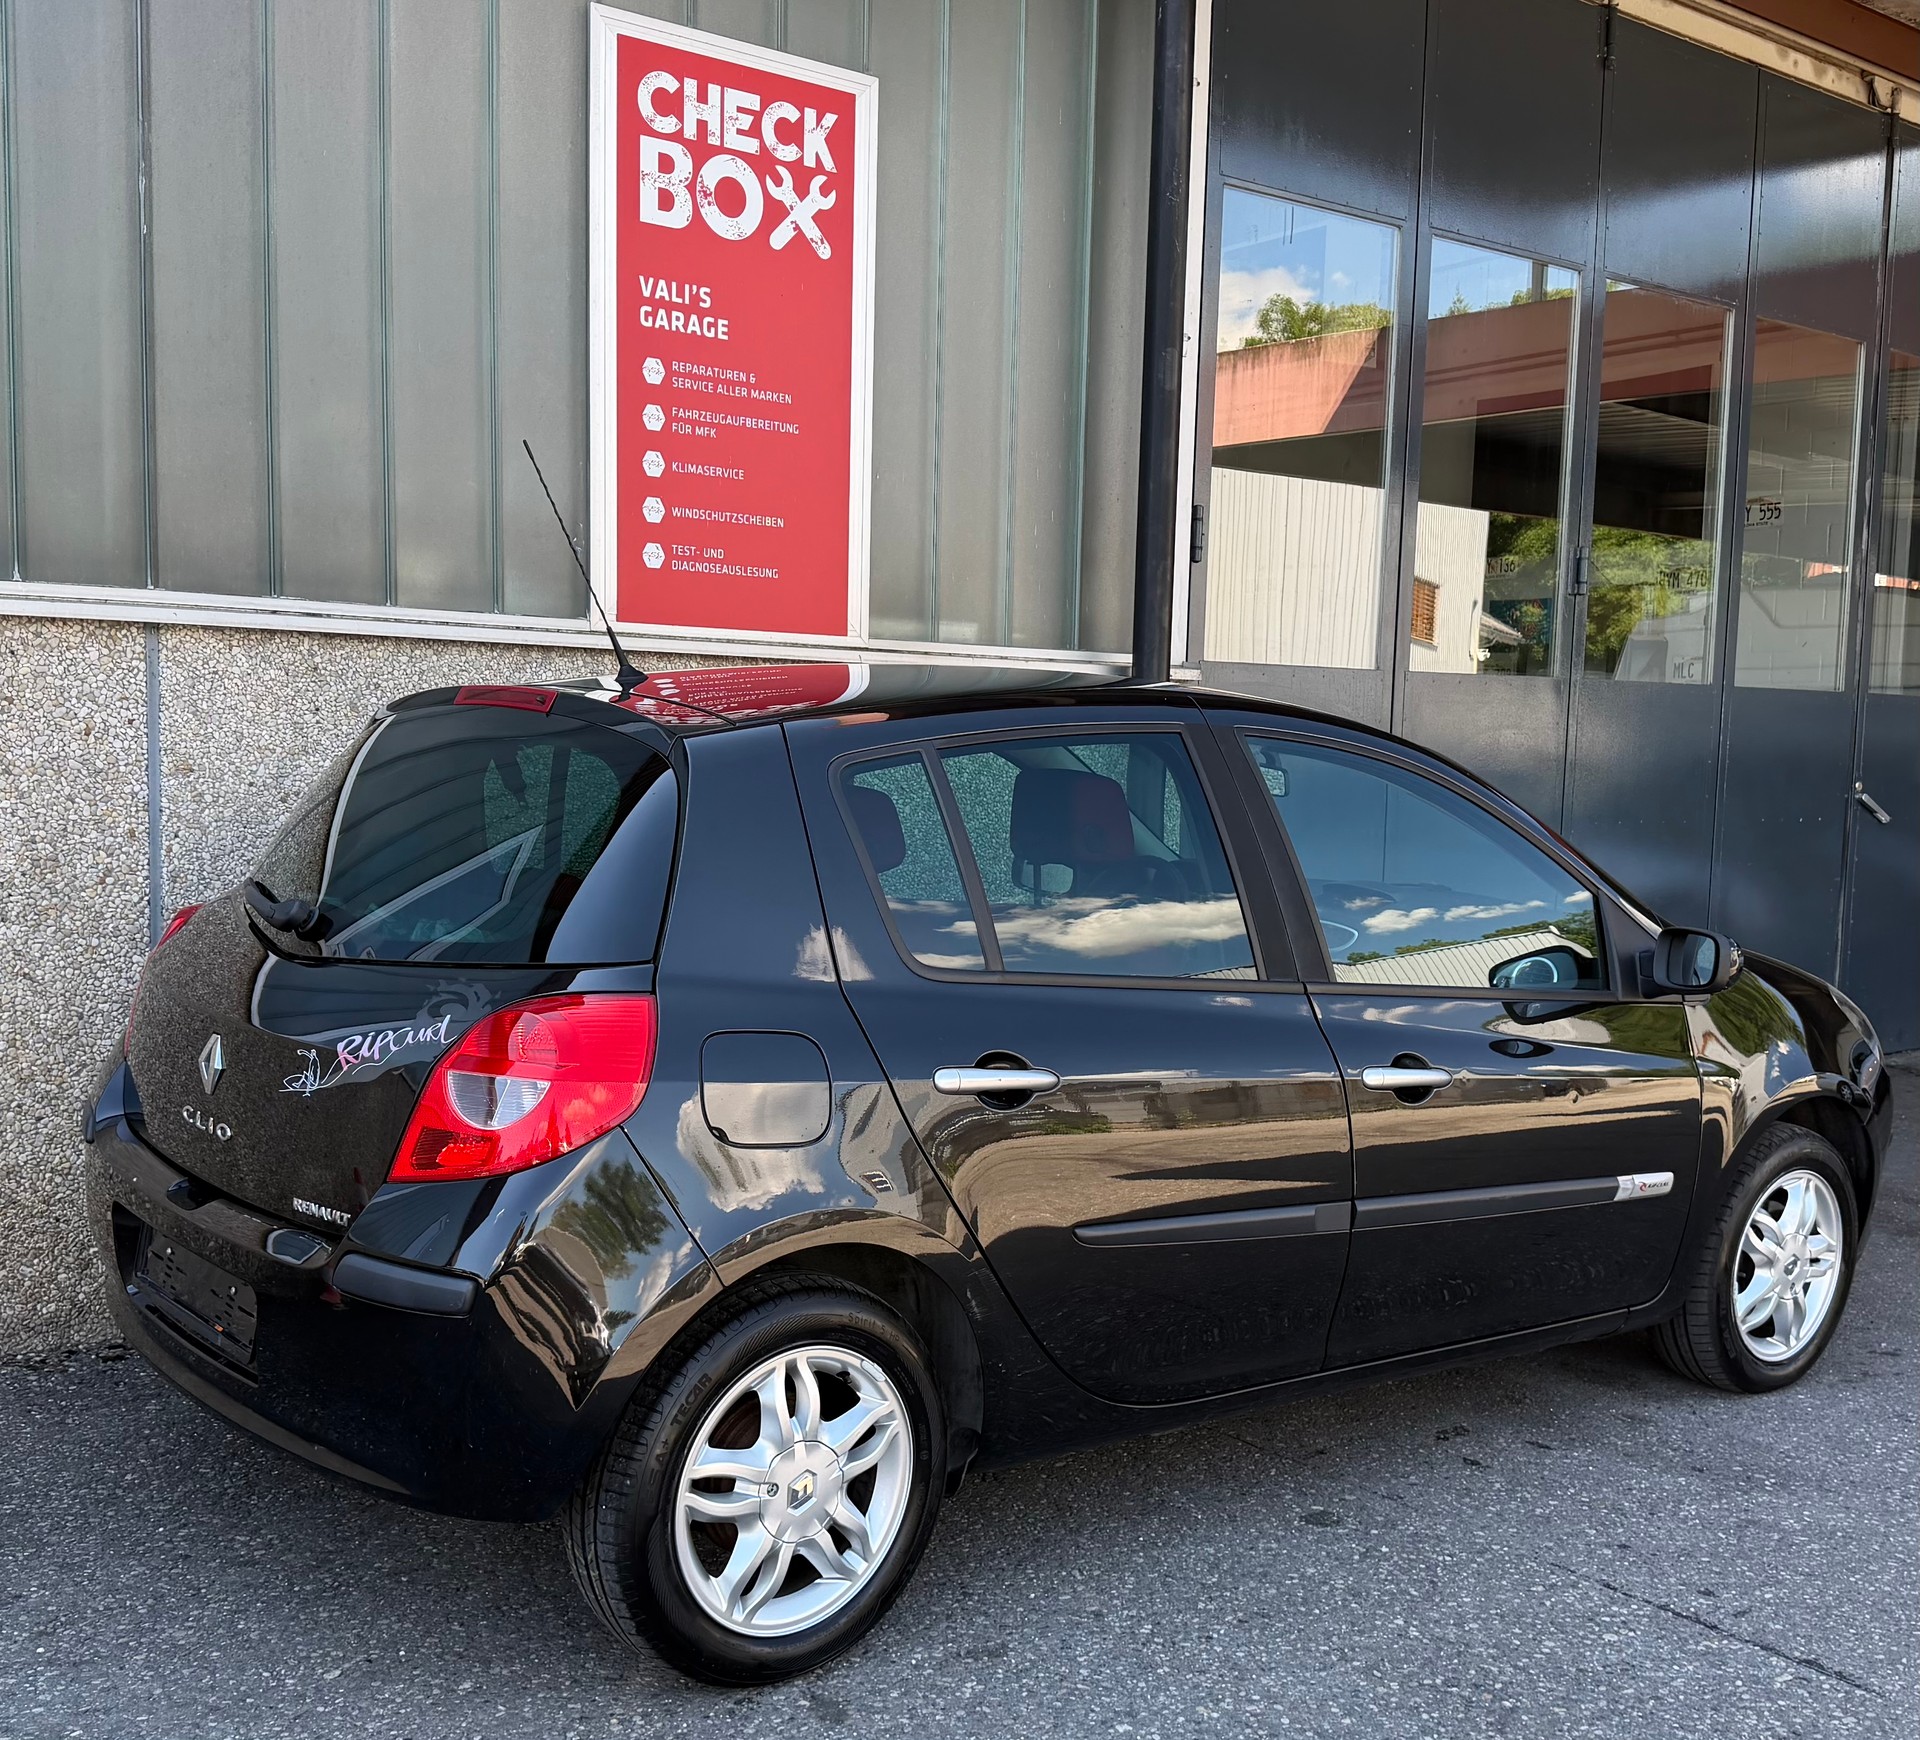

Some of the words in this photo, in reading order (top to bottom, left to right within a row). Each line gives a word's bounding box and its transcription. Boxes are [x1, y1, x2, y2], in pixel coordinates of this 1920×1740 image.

[637, 70, 839, 173] CHECK
[639, 134, 837, 260] BOX
[638, 275, 712, 308] VALI'S
[639, 305, 729, 340] GARAGE
[672, 360, 747, 382] REPARATUREN
[749, 373, 756, 384] &
[672, 377, 714, 393] SERVICE
[716, 384, 748, 398] ALLER
[750, 389, 792, 404] MARKEN
[672, 407, 799, 434] FAHRZEUGAUFBEREITUNG
[672, 422, 692, 435] FÜR
[695, 427, 717, 438] MFK
[672, 461, 745, 480] KLIMASERVICE
[671, 507, 784, 528] WINDSCHUTZSCHEIBEN
[1759, 501, 1781, 521] 555
[671, 545, 700, 556] TEST-
[703, 548, 724, 559] UND
[671, 560, 779, 579] DIAGNOSEAUSLESUNG
[1672, 662, 1694, 679] MLC
[182, 1105, 232, 1141] CLIO
[292, 1197, 351, 1227] RENAULT
[670, 1372, 713, 1427] TECAR
